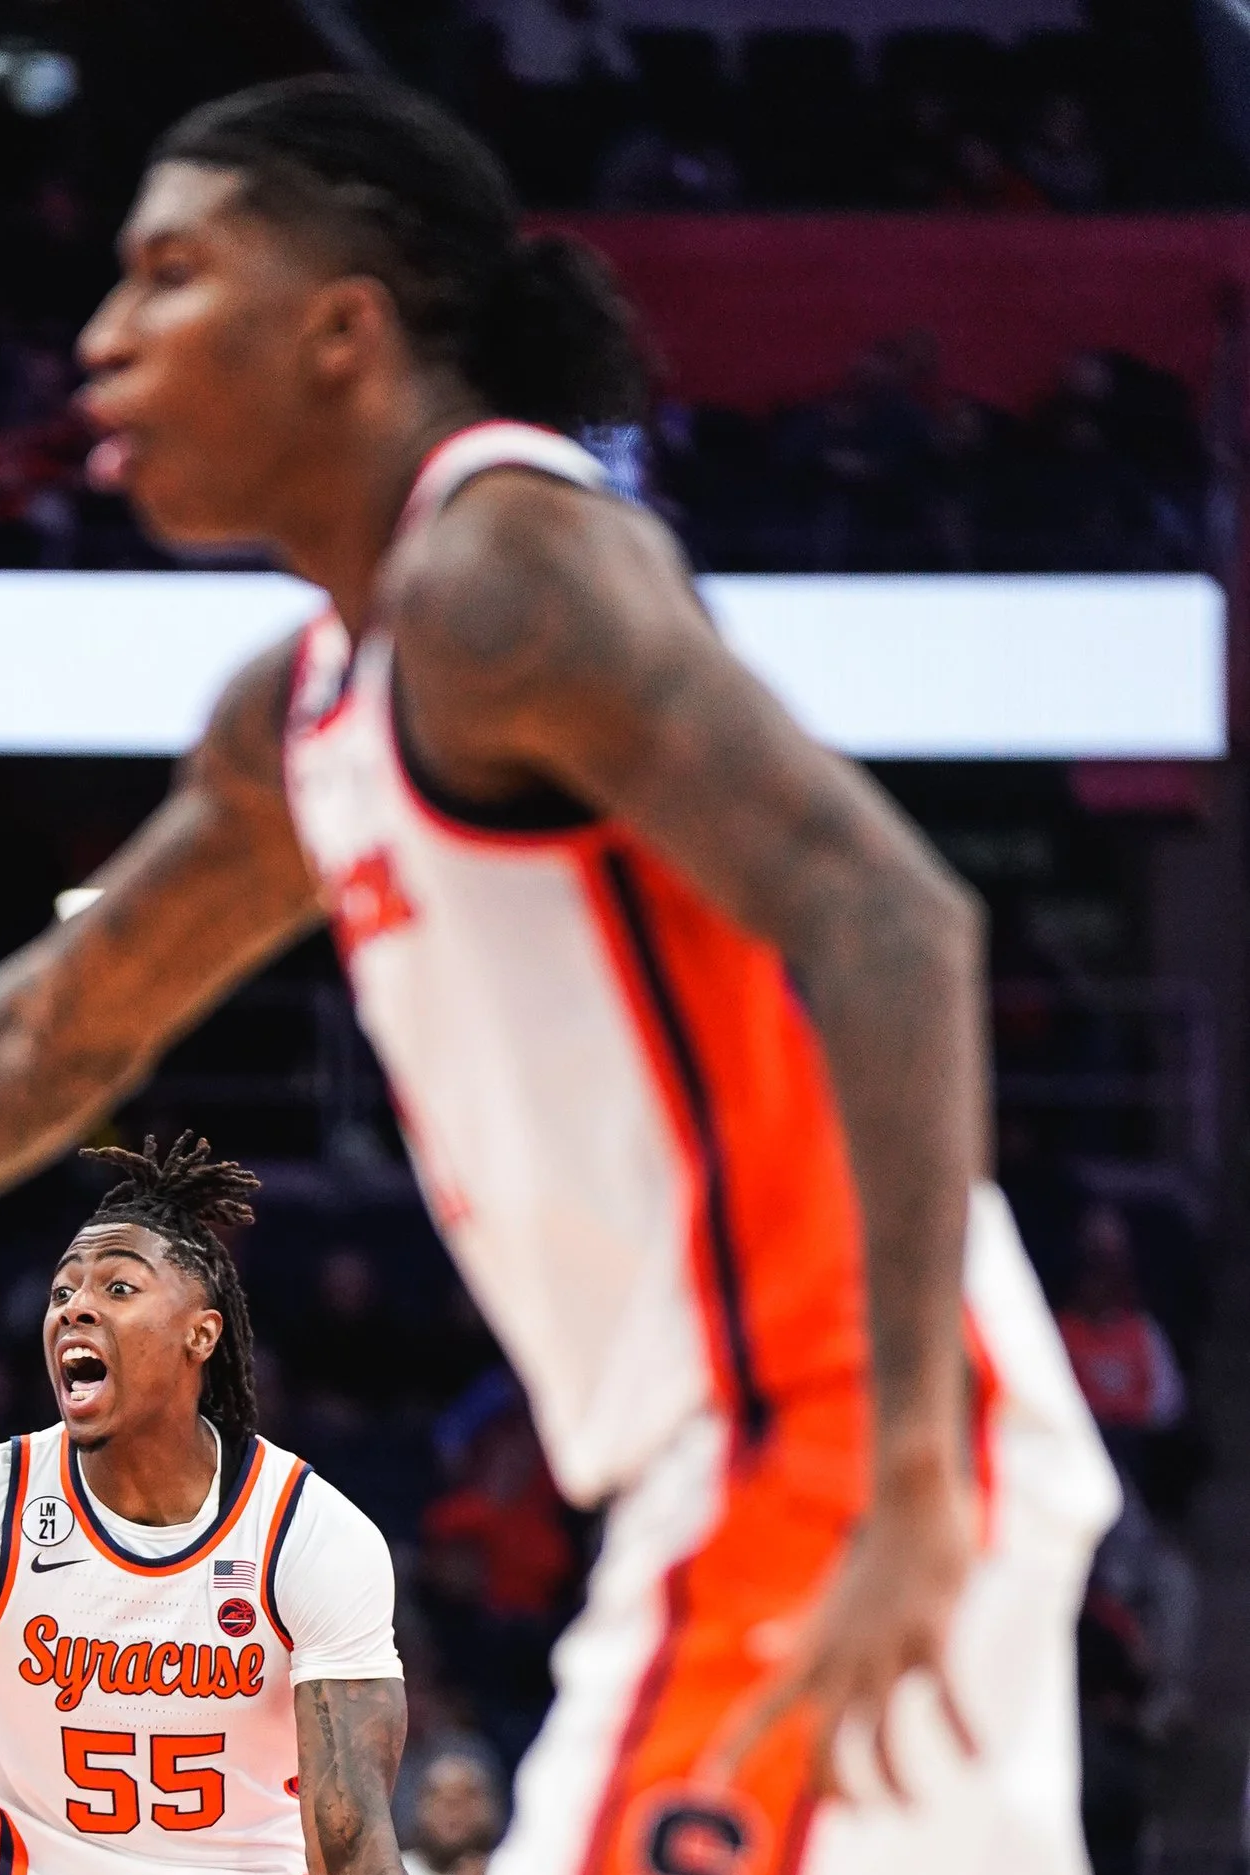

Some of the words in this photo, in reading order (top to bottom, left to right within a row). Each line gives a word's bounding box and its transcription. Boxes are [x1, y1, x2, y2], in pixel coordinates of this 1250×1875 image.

[39, 1518, 56, 1540] 21
[40, 1502, 56, 1517] LM
[18, 1614, 265, 1712] Syracuse
[61, 1726, 226, 1835] 55
